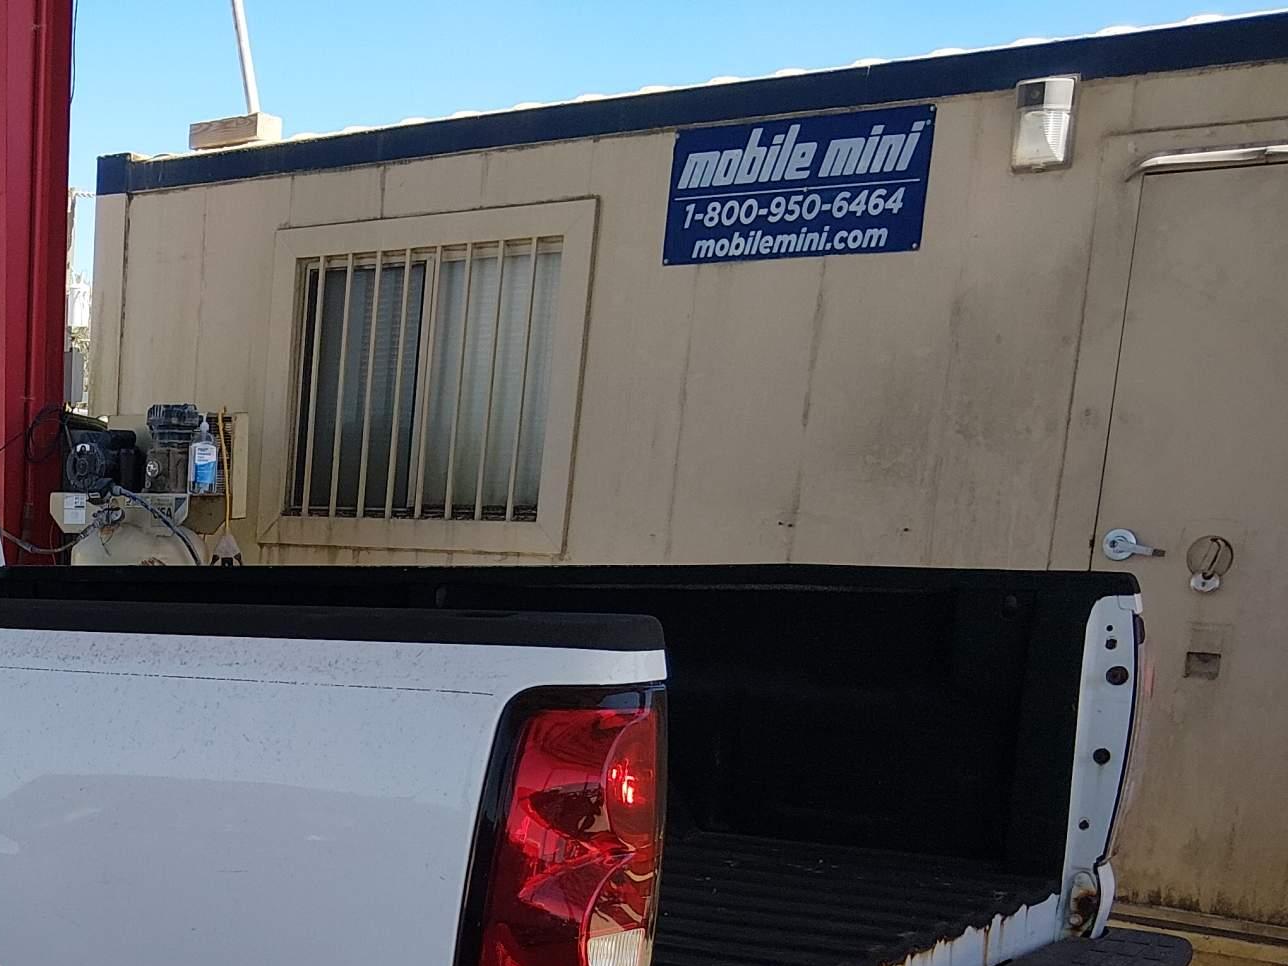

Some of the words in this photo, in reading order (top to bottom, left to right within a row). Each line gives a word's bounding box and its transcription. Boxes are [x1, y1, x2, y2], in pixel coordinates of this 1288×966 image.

[677, 123, 818, 190] mobile
[818, 120, 926, 178] mini
[683, 187, 906, 229] 1-800-950-6464
[691, 225, 888, 259] mobilemini.com
